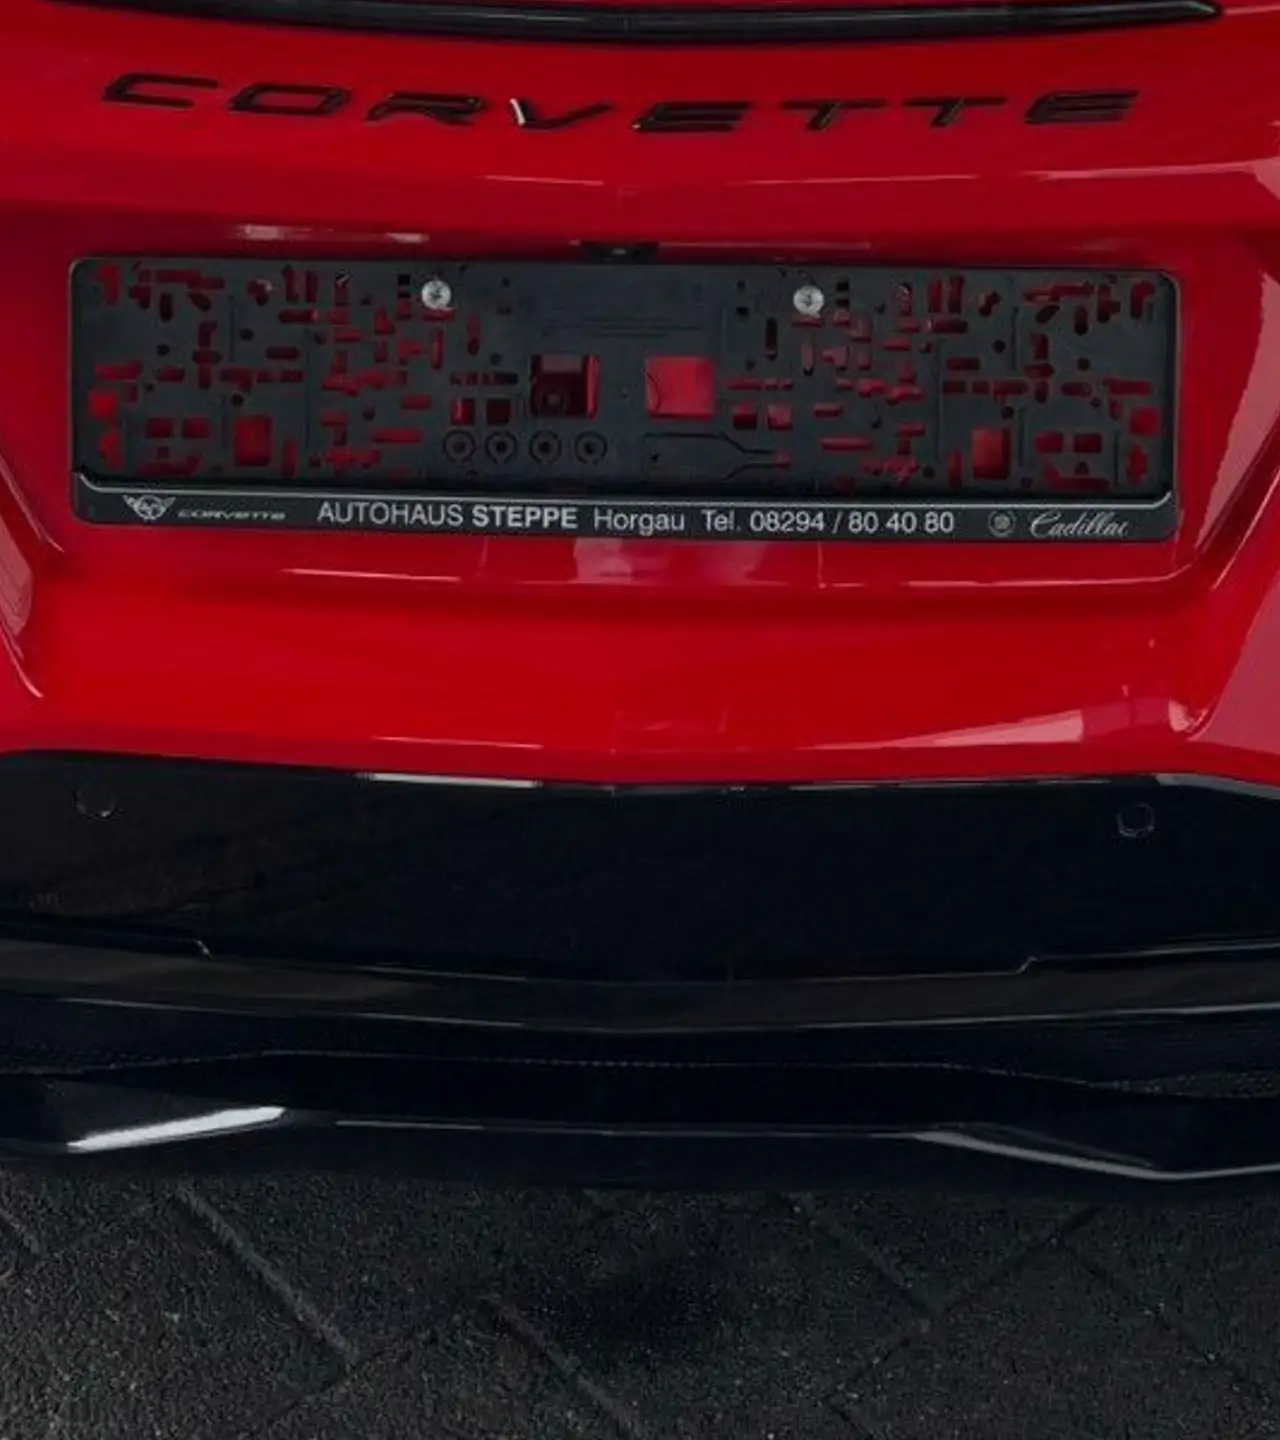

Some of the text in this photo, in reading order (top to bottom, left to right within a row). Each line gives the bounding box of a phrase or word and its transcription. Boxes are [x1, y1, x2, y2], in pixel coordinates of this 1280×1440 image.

[100, 72, 1138, 134] CORVETTE
[176, 509, 287, 522] CORVETTE
[317, 502, 463, 526] AUTOHAUS
[472, 504, 578, 529] STEPPE
[594, 508, 685, 537] Horgau
[700, 509, 741, 533] Tel.
[750, 510, 824, 533] 08294
[848, 511, 879, 534] 80
[885, 511, 917, 534] 40
[924, 511, 955, 534] 80
[1029, 509, 1129, 539] Cadillac
